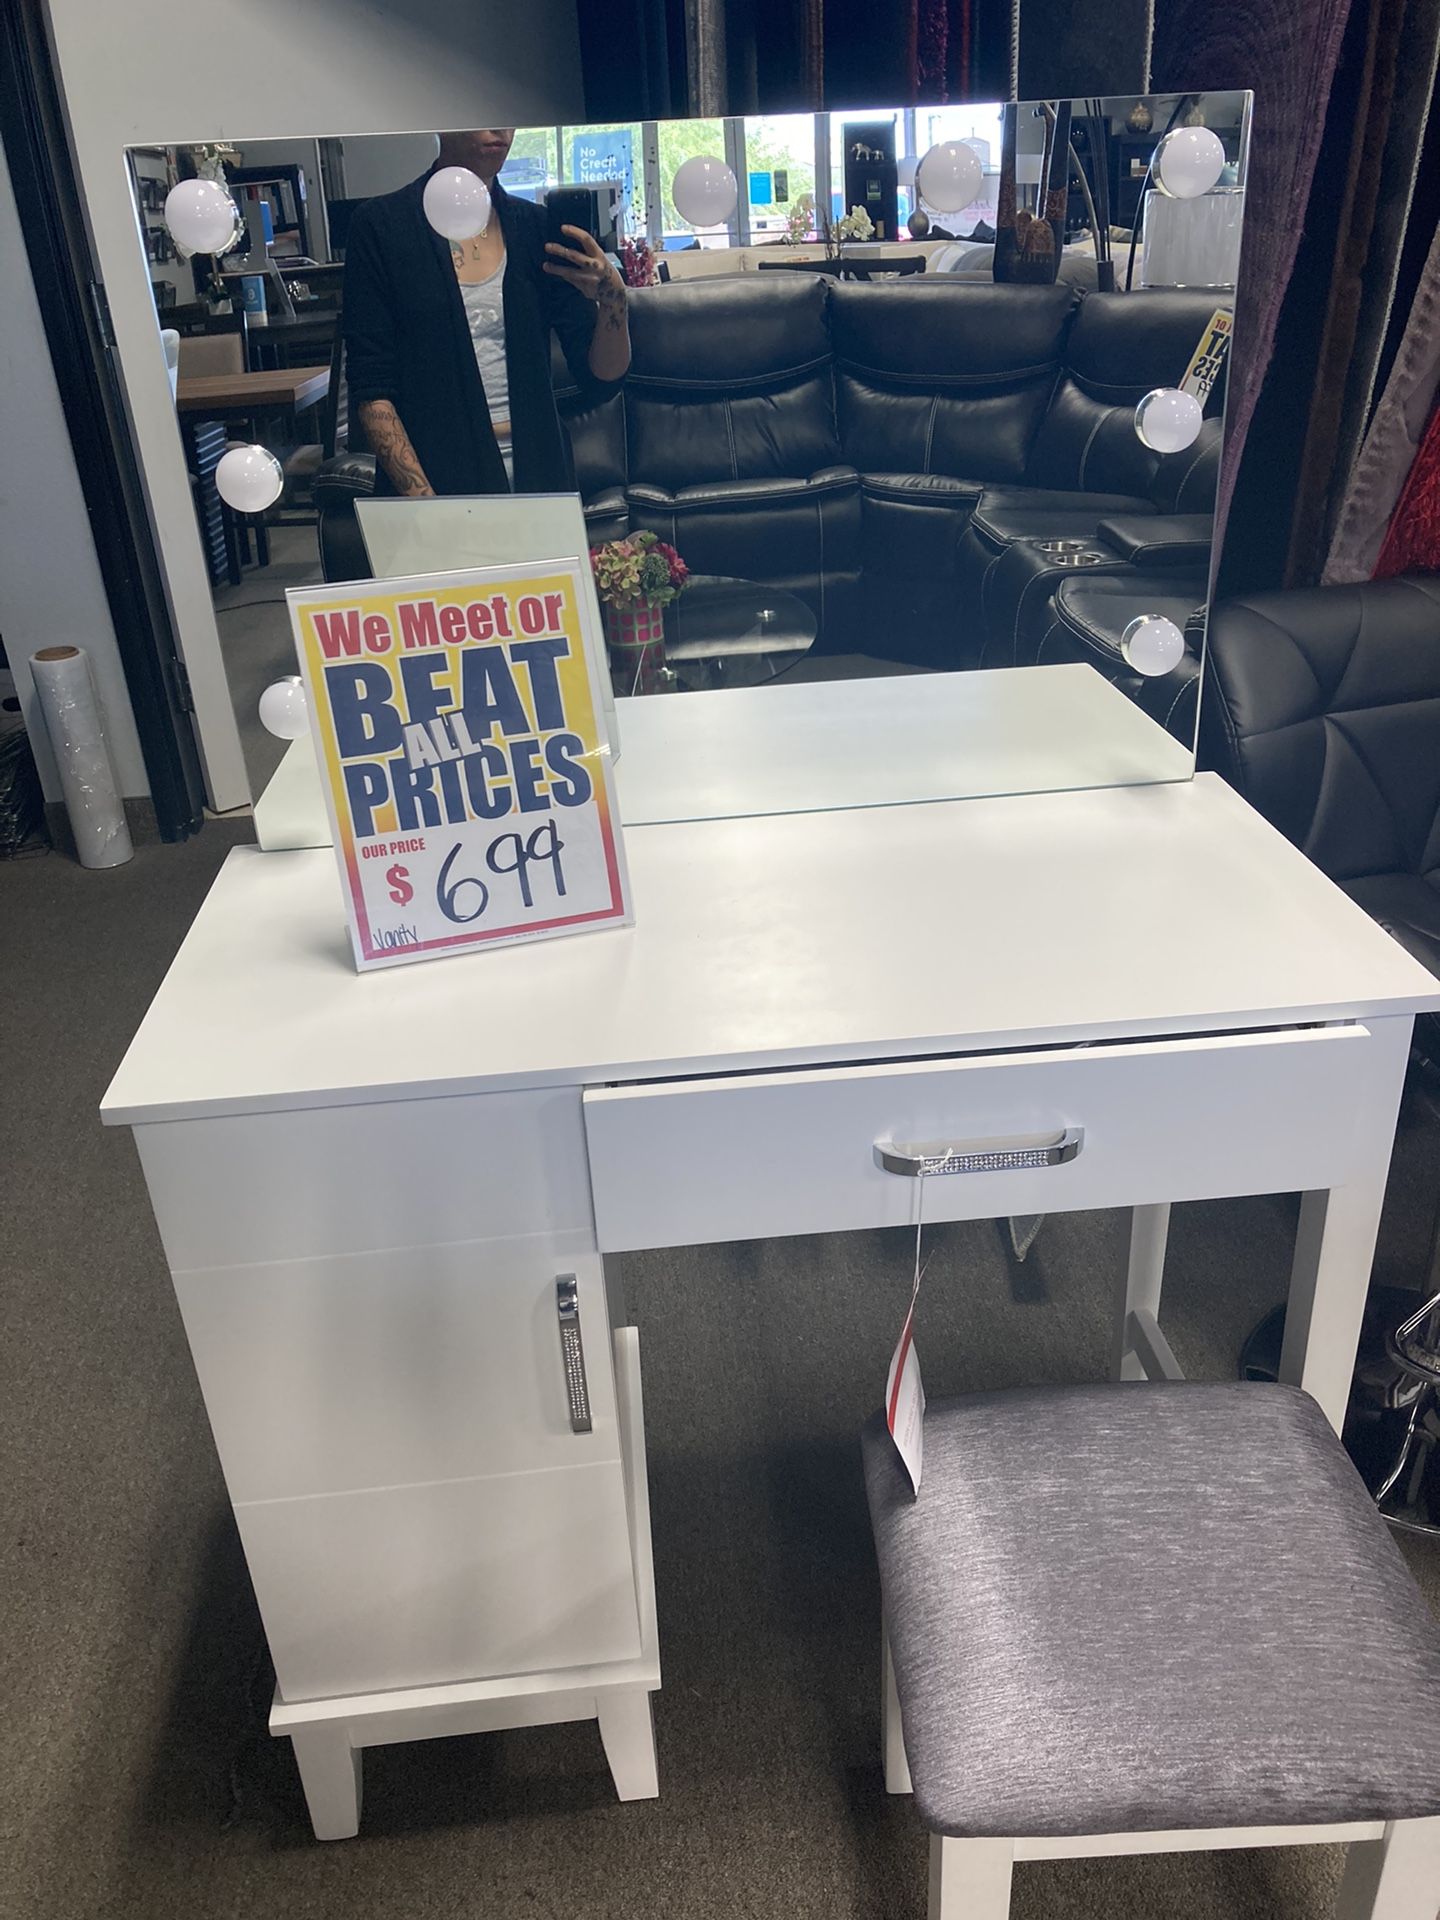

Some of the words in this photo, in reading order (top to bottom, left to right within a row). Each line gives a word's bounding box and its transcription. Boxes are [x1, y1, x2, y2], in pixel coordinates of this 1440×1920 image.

[580, 146, 597, 158] No
[580, 155, 618, 170] Credit
[580, 167, 627, 183] Needed
[312, 607, 391, 659] We
[397, 595, 513, 649] Meet
[518, 592, 564, 633] or
[324, 638, 570, 759] BEAT
[402, 712, 482, 770] ALL
[344, 733, 592, 838] PRICES
[361, 844, 388, 860] OUR
[389, 837, 426, 856] PRICE
[436, 818, 567, 923] 699
[386, 863, 415, 907] $
